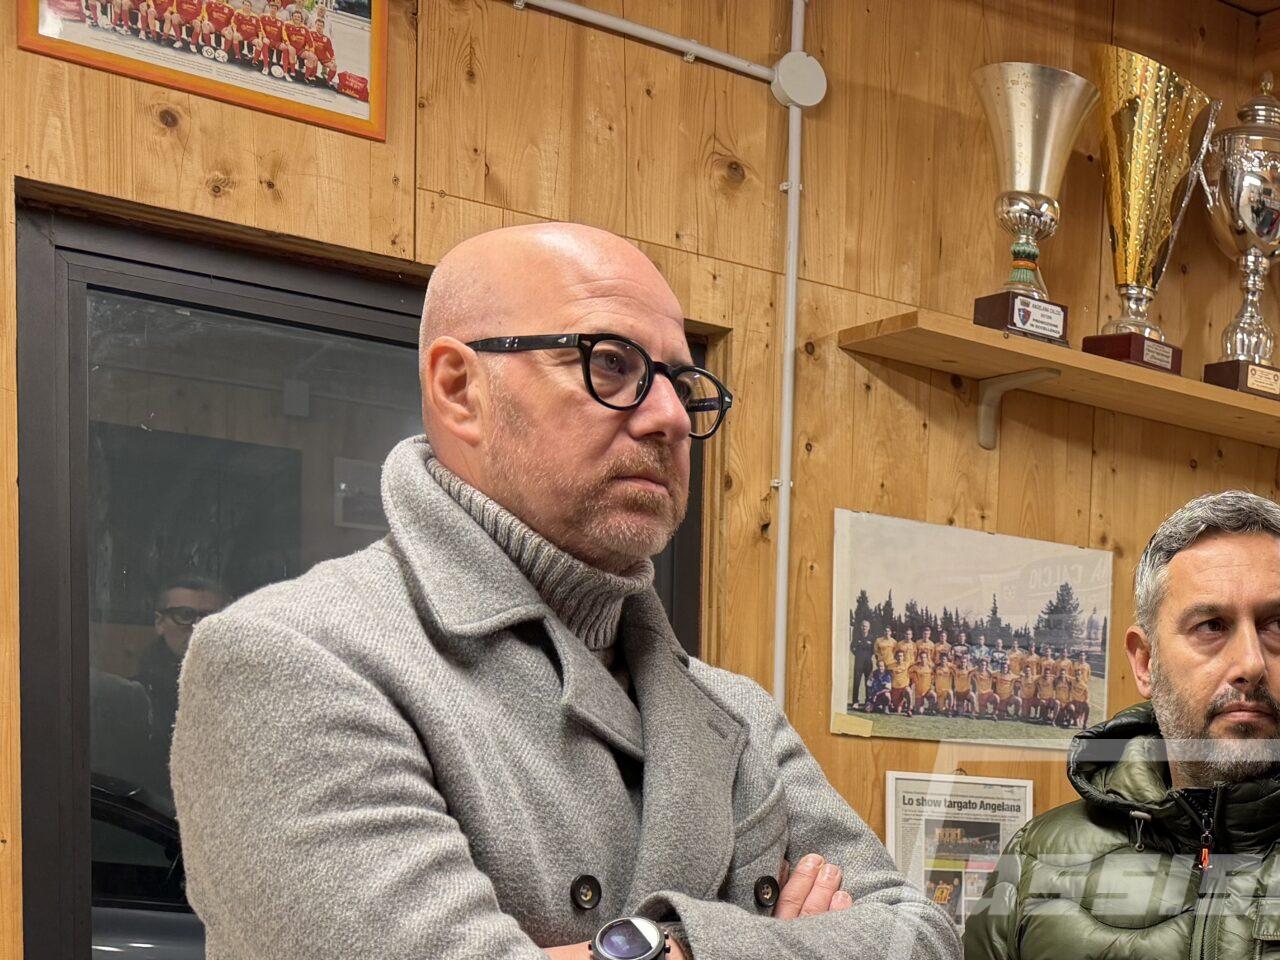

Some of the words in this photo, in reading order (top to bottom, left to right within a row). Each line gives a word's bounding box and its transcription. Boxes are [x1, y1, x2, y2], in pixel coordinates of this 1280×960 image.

[902, 795, 914, 806] Lo
[916, 796, 943, 808] show
[944, 798, 978, 811] targato
[979, 800, 1021, 814] Angelana
